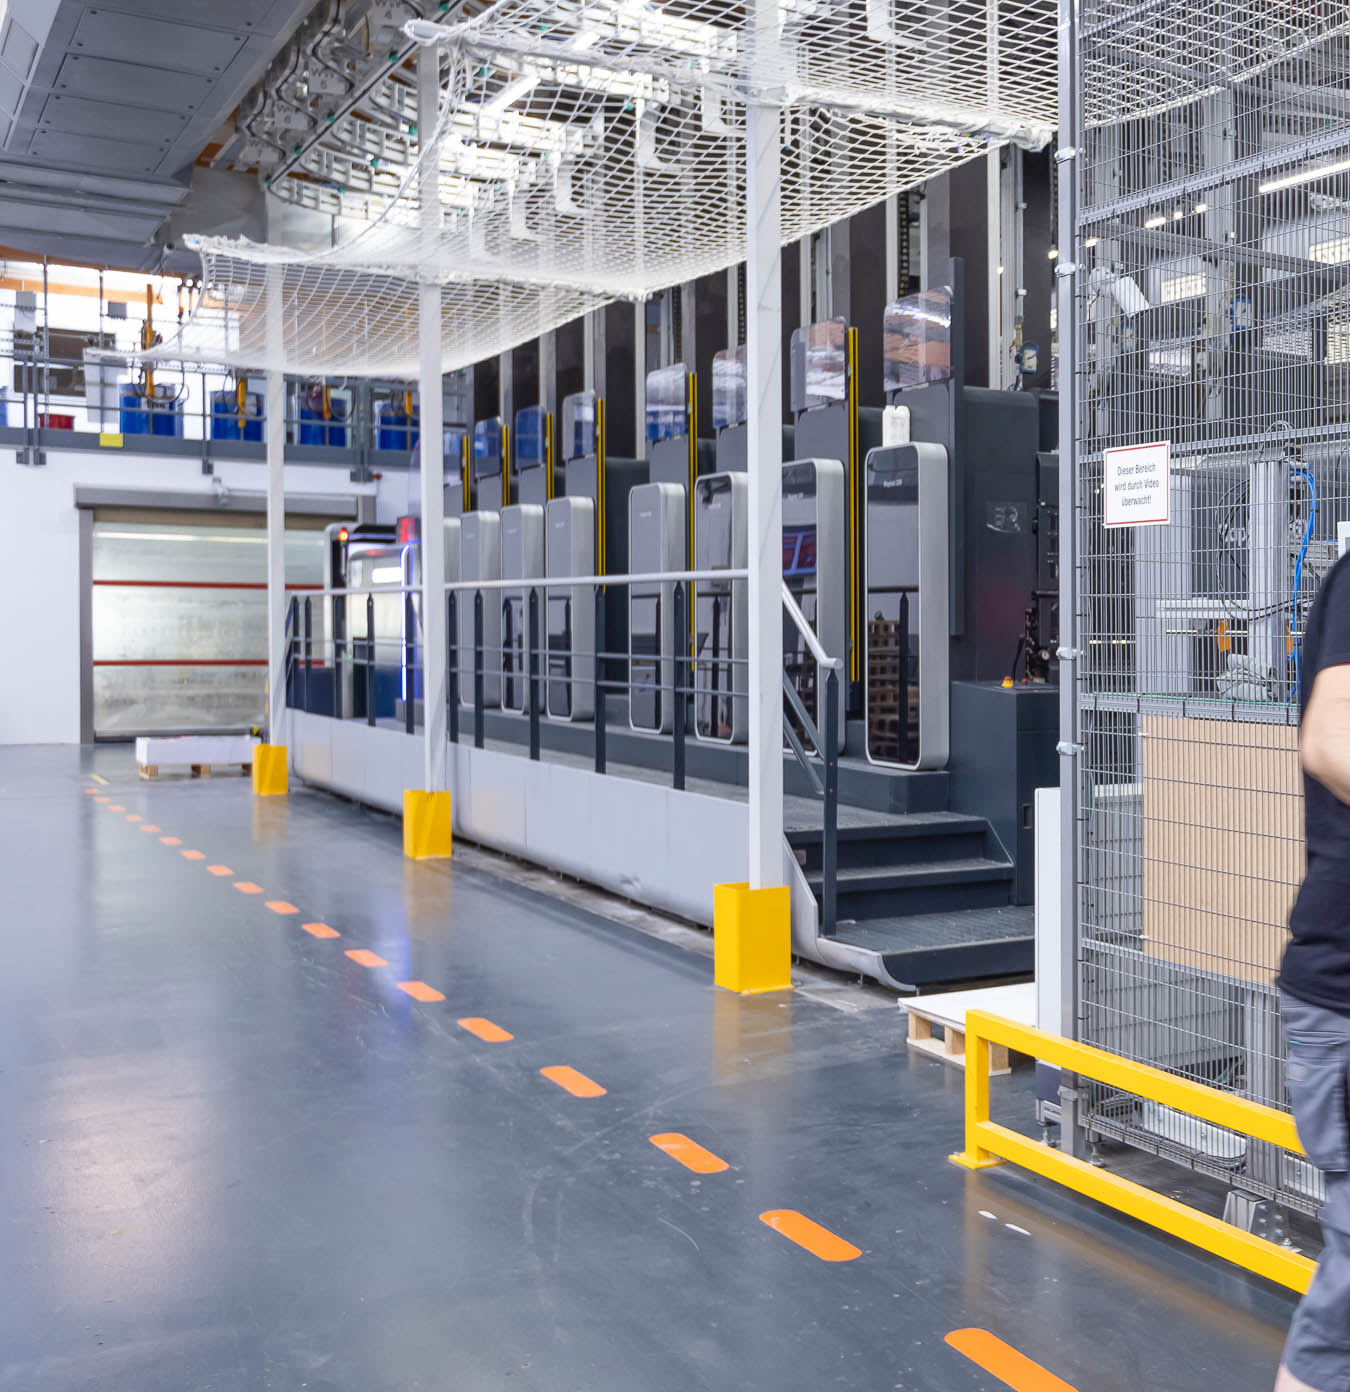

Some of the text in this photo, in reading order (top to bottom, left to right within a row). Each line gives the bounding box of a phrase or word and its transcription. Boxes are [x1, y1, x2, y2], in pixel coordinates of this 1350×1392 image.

[1117, 463, 1156, 476] Dieser Bereich
[1114, 478, 1159, 492] wird durch Video
